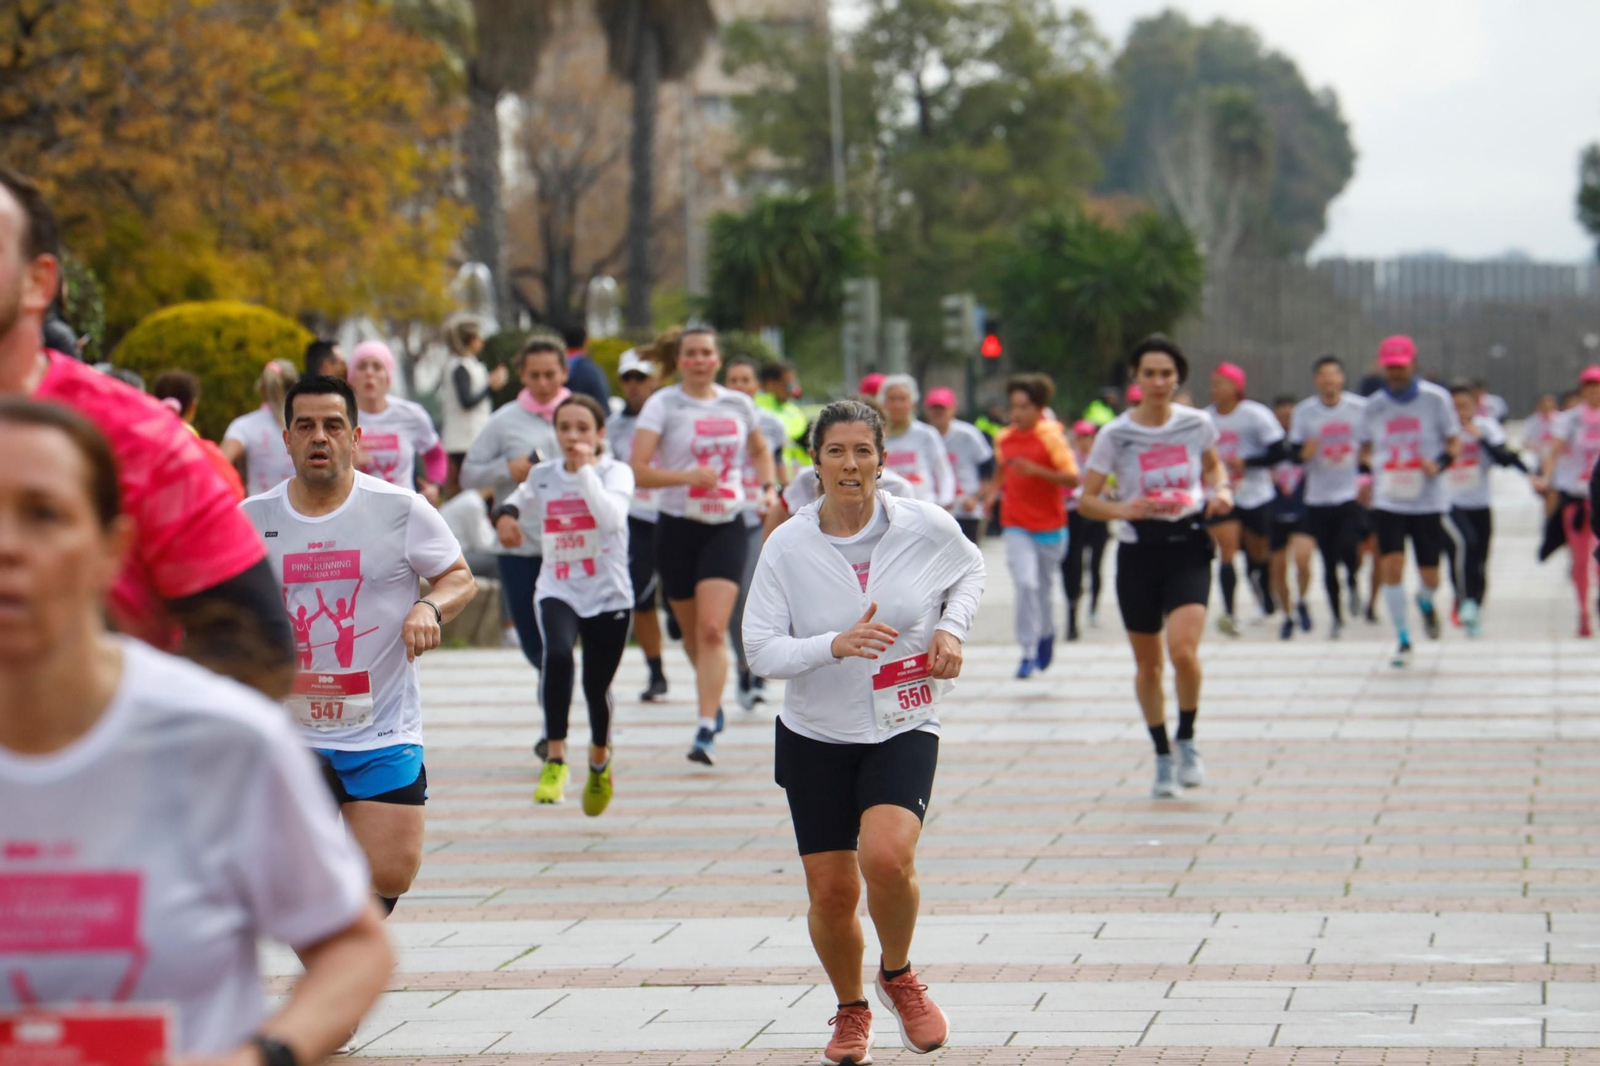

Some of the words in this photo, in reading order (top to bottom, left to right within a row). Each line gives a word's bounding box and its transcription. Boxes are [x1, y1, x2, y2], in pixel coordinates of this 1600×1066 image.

[291, 563, 312, 571] PINK
[314, 560, 351, 571] RUNNING
[897, 684, 932, 710] 550
[310, 702, 344, 720] 547
